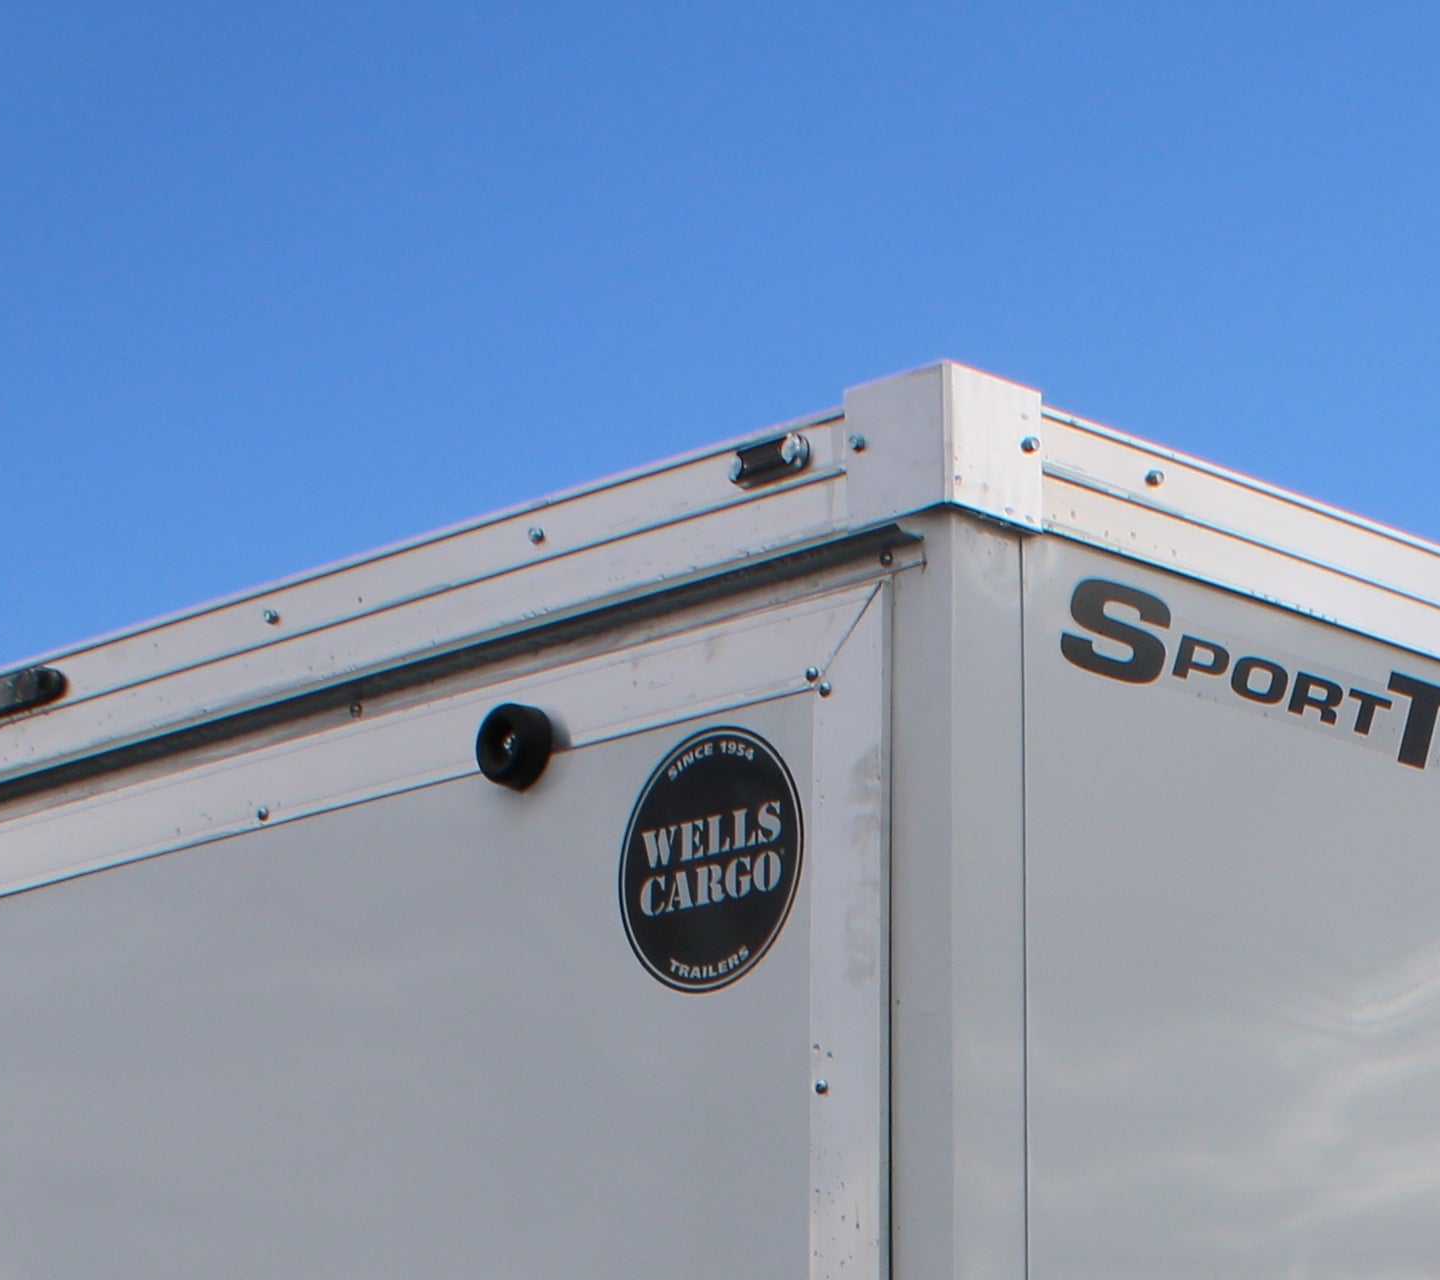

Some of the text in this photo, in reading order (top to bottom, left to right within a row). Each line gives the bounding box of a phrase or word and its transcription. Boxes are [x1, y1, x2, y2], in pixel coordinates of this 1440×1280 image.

[668, 741, 755, 781] SINCE 1954
[642, 800, 782, 869] WELLS
[640, 849, 782, 917] CARGO
[670, 945, 749, 979] TRAILERS
